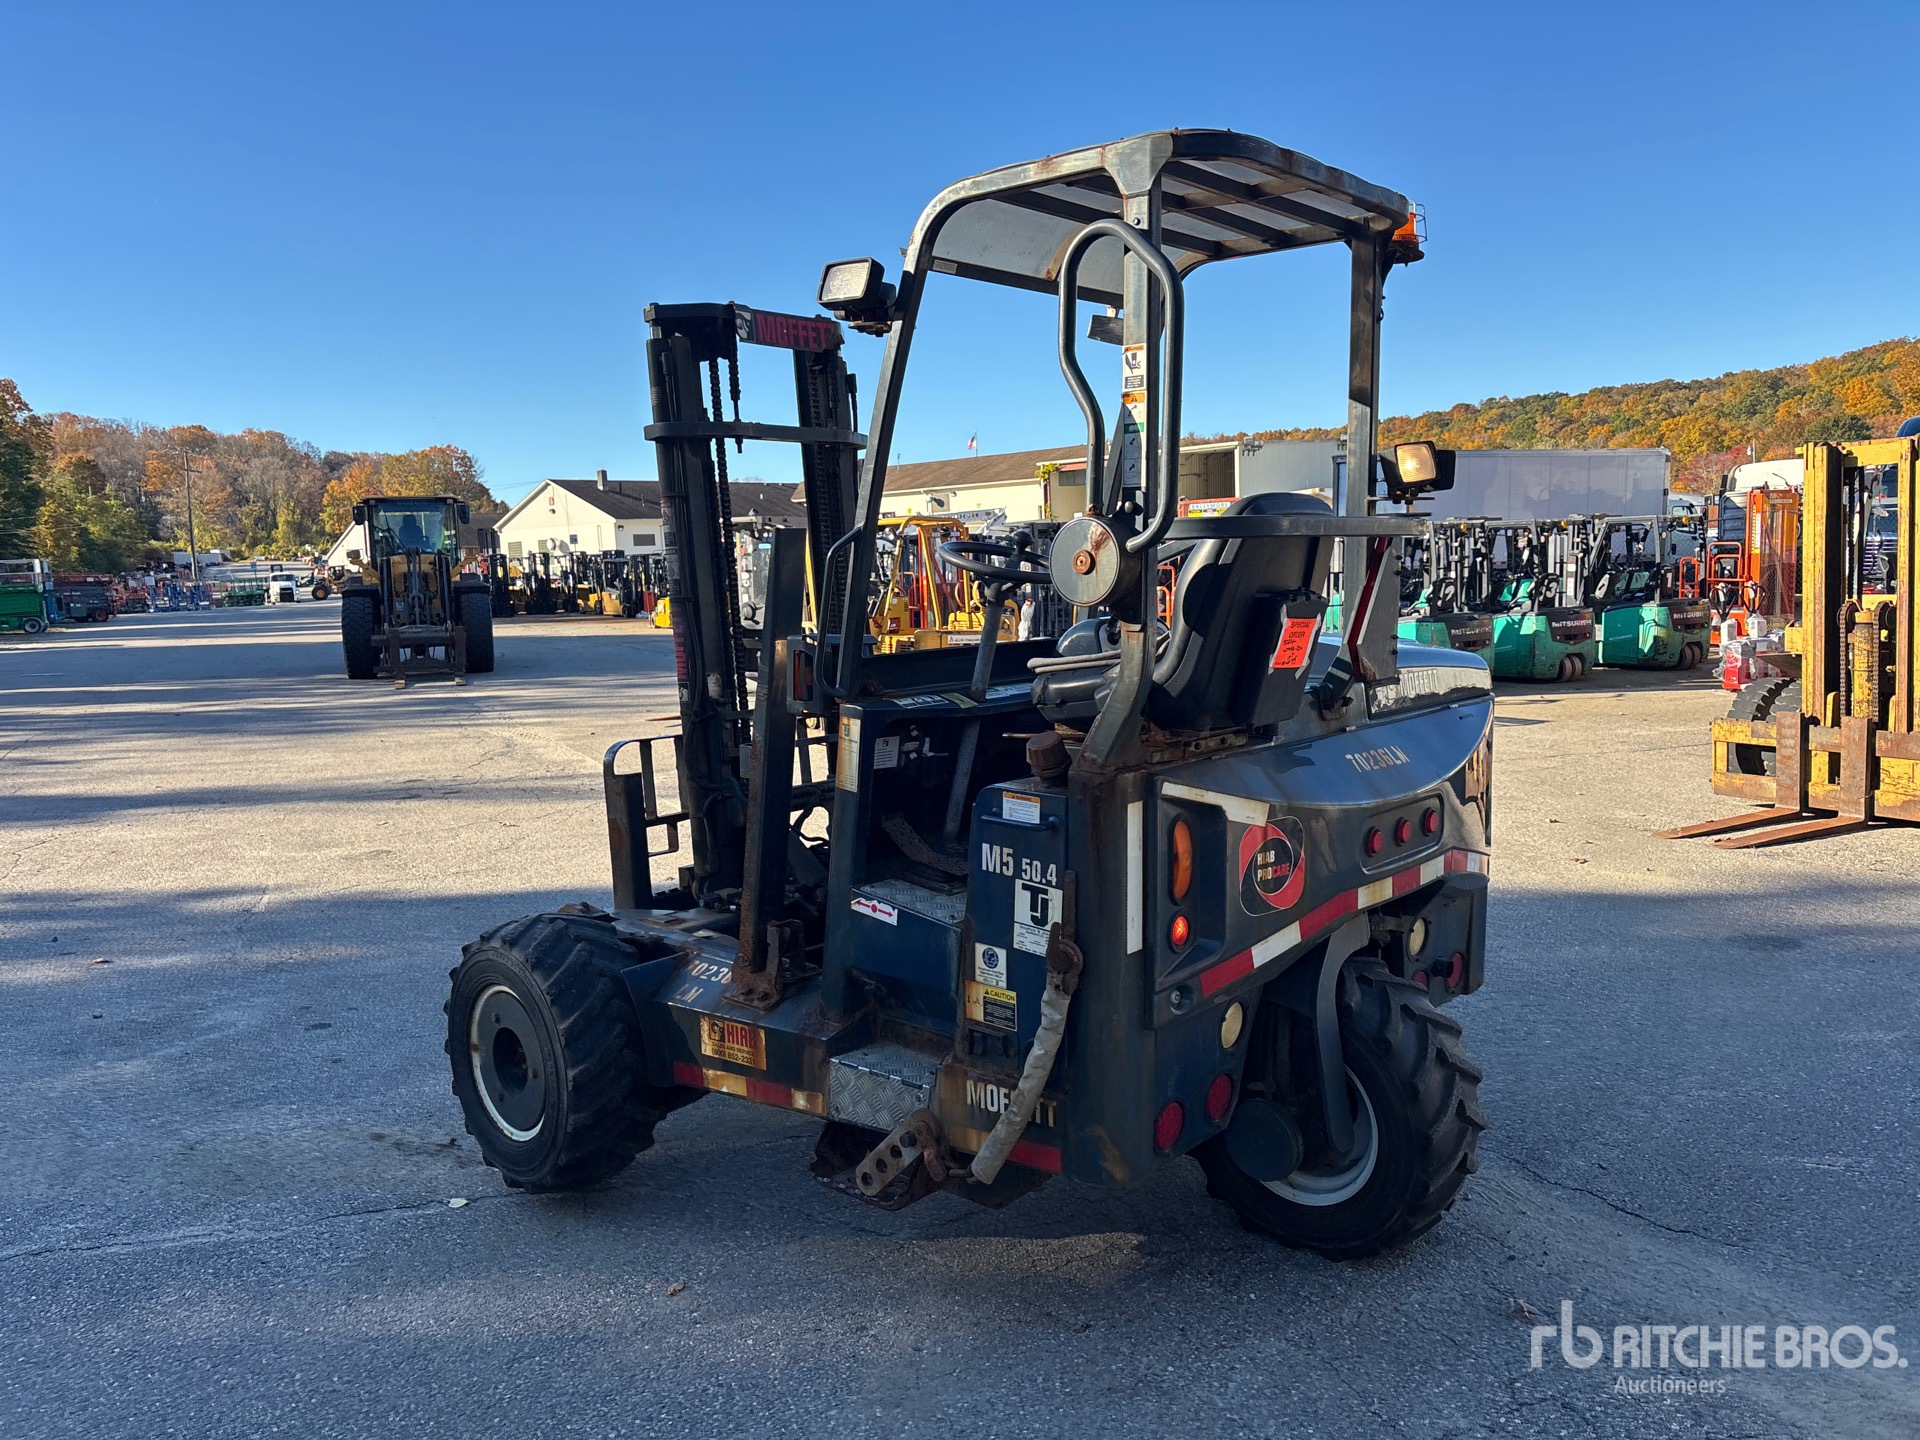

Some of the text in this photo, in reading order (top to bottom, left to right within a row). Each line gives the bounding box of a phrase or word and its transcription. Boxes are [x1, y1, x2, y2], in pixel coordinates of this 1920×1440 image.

[1545, 582, 1558, 598] 3
[1673, 611, 1709, 620] MITSUBI
[1398, 668, 1438, 699] MOFFETT
[1345, 745, 1411, 773] 70236LM
[981, 842, 1057, 887] M5 50.4
[1257, 850, 1276, 866] HIAB
[989, 989, 1016, 1002] CAUTION
[966, 1079, 1057, 1128] MOFTT
